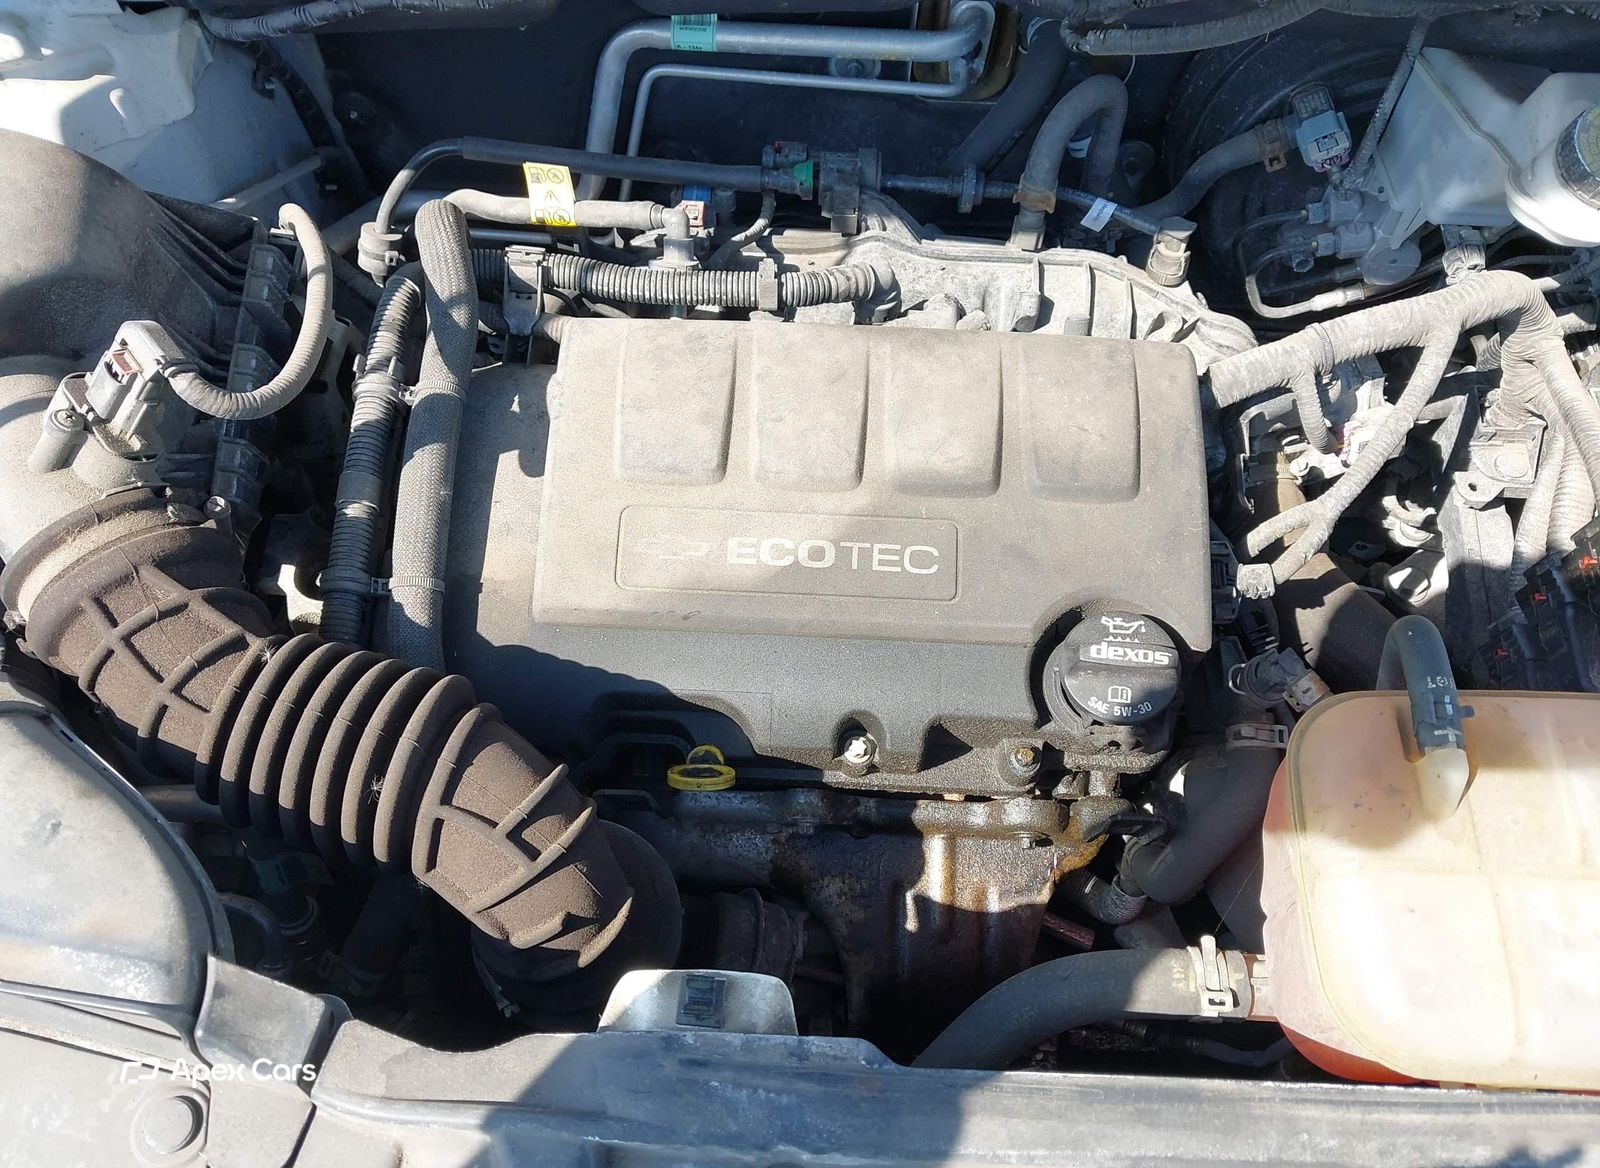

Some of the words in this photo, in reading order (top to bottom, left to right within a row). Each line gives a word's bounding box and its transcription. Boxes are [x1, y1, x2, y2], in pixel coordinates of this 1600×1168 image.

[726, 536, 940, 575] ECOTEC
[1089, 642, 1173, 665] dexos
[1087, 696, 1110, 714] SAE
[1113, 701, 1152, 717] 5W-30
